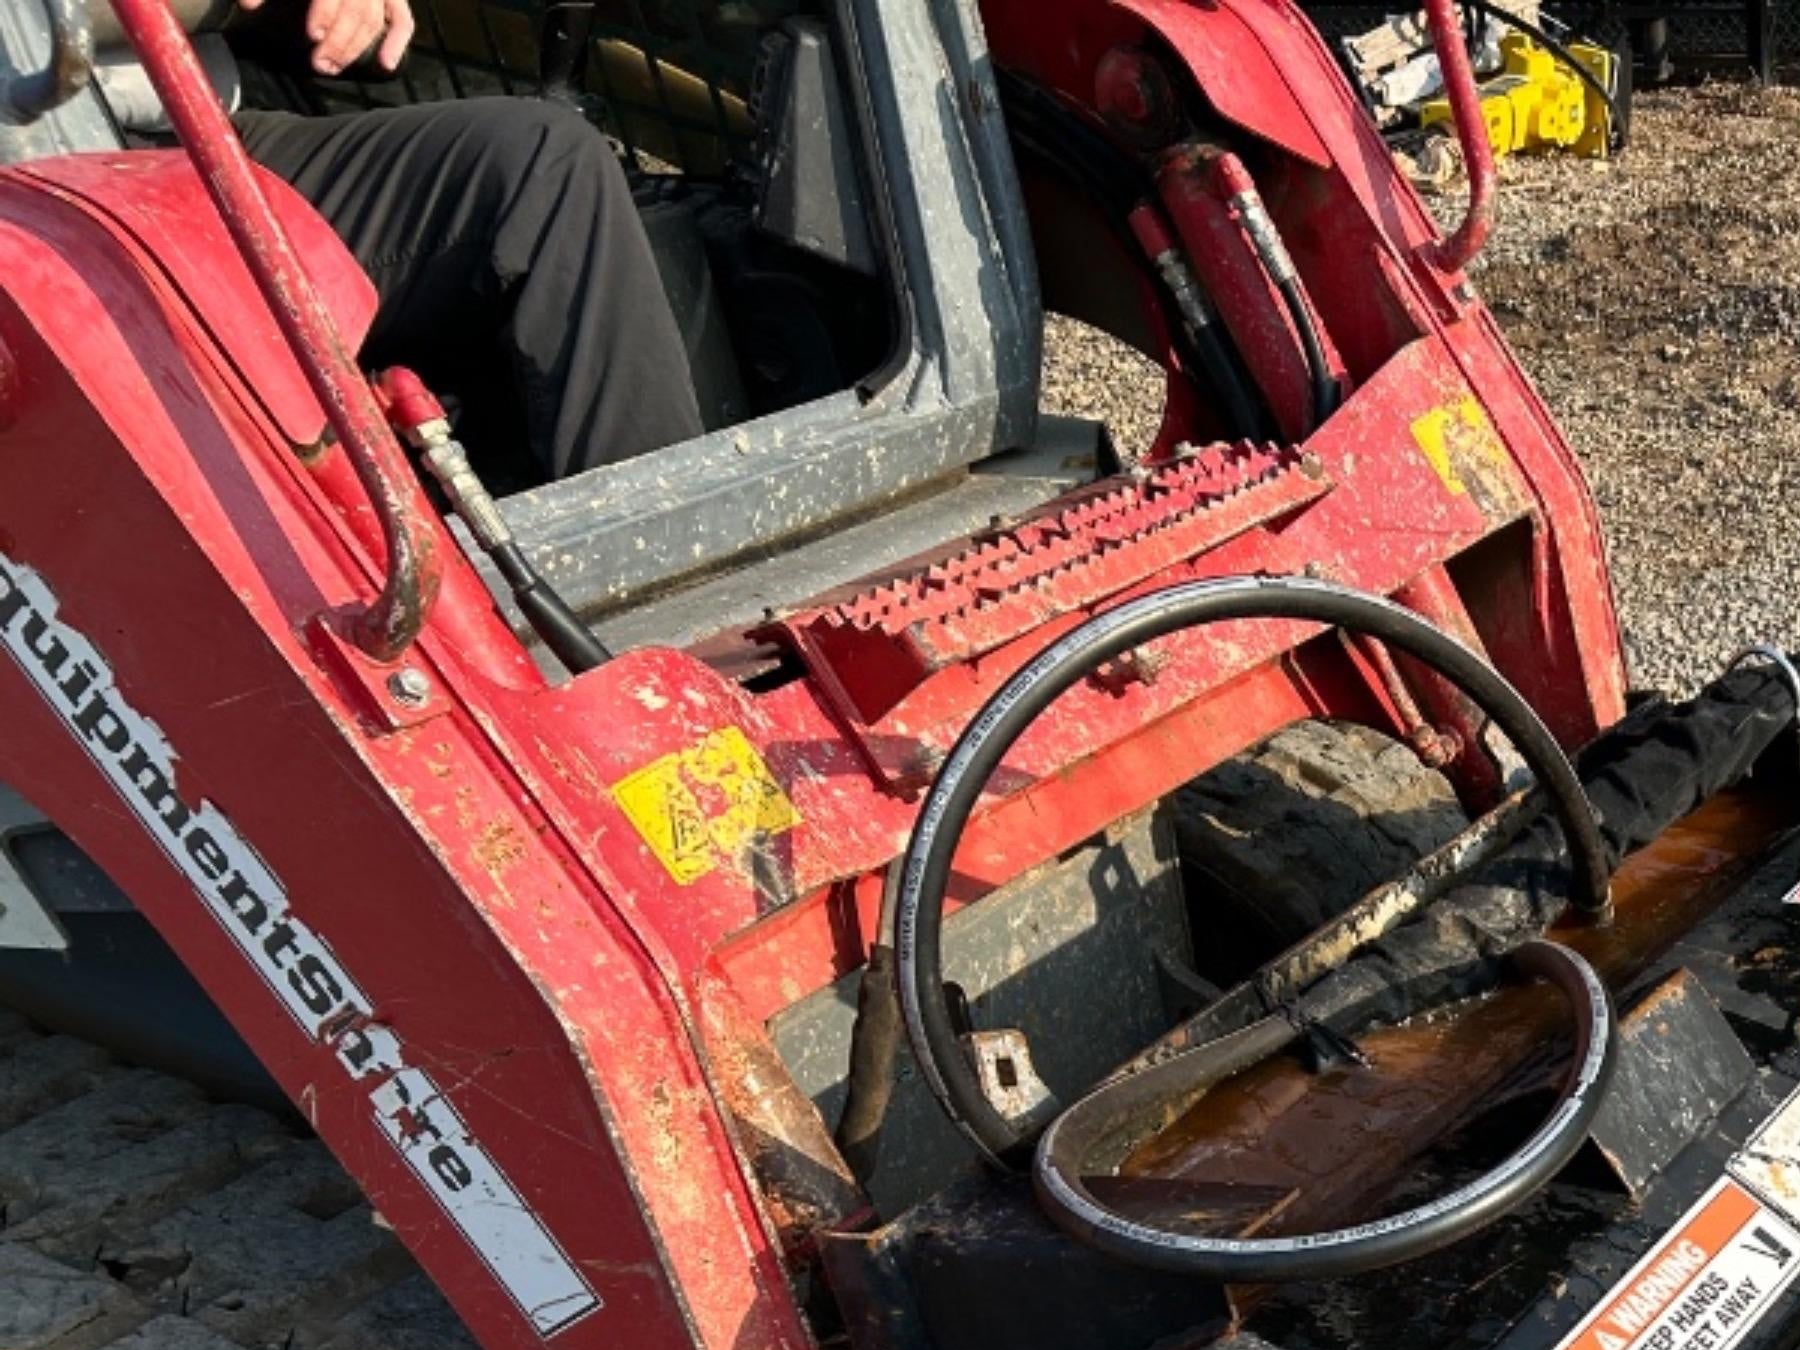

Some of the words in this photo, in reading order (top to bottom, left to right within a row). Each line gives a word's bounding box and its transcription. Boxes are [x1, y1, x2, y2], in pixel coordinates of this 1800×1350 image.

[1607, 1239, 1709, 1332] WARNING
[1668, 1271, 1729, 1333] HANDS
[1715, 1276, 1762, 1330] AWAY
